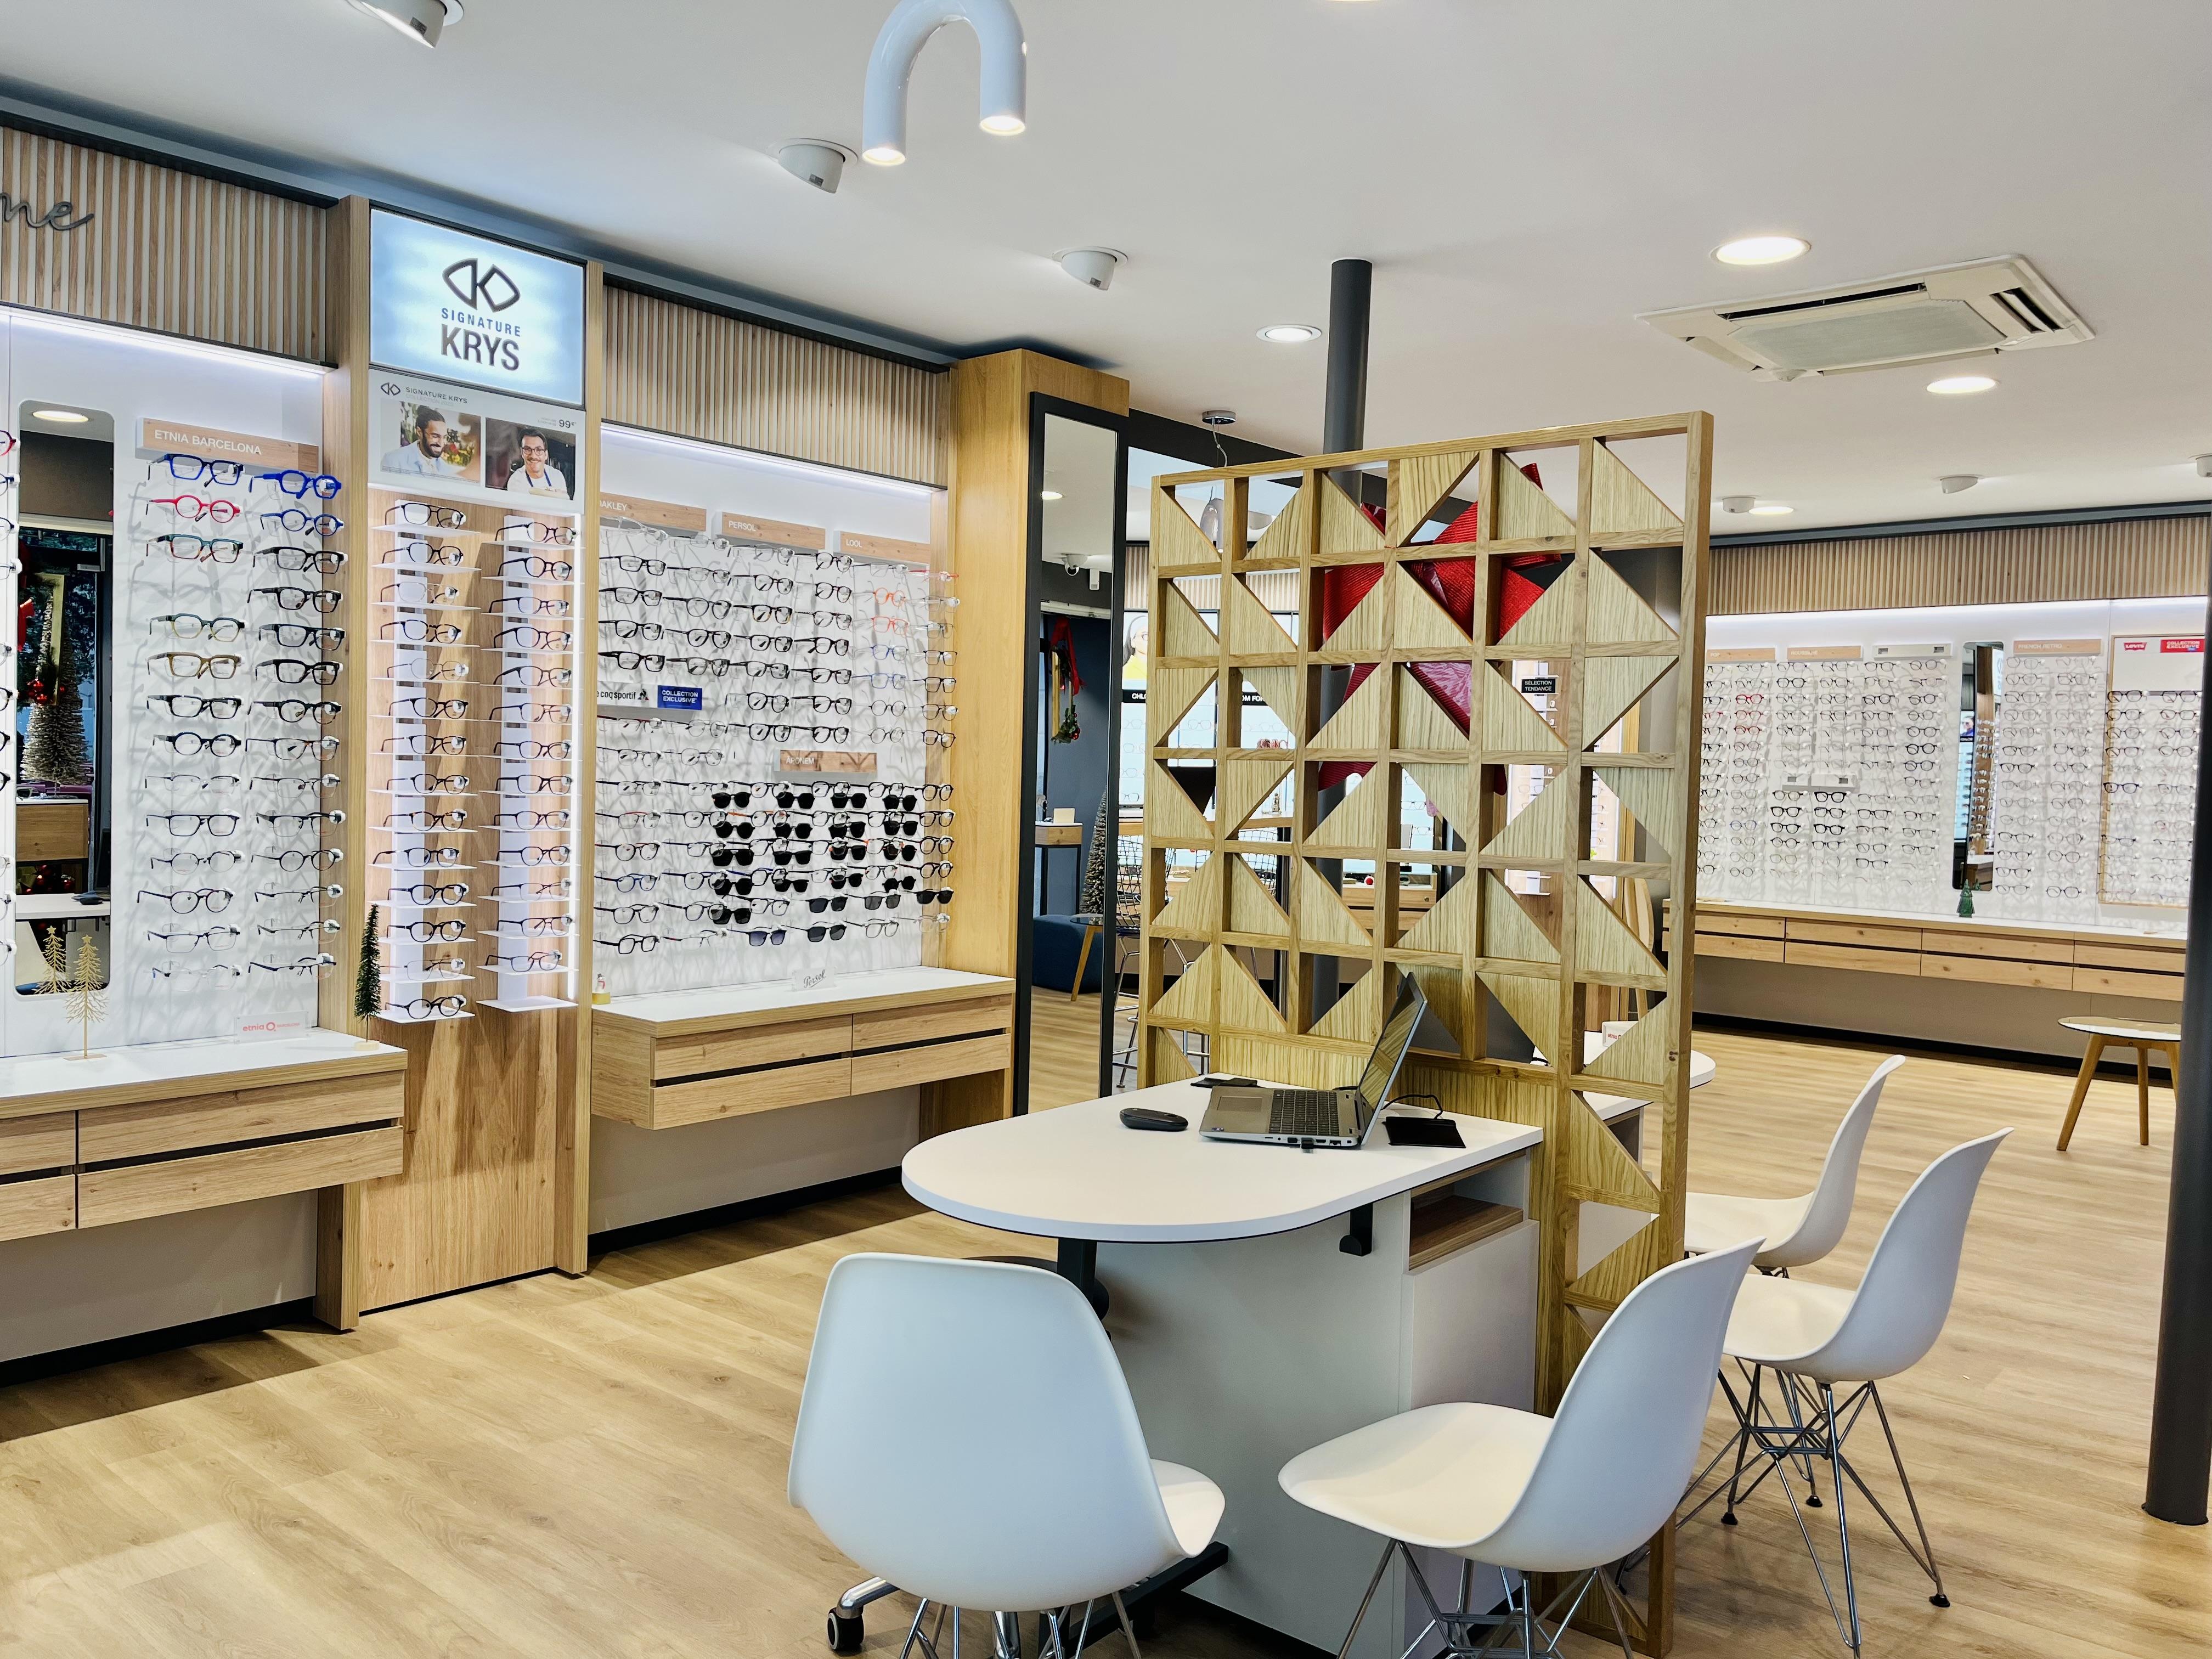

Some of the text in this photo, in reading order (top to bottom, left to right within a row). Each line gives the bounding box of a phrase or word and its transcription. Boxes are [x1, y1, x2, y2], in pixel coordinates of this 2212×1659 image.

[441, 308, 521, 337] SIGNATURE
[441, 324, 520, 371] KRYS
[406, 387, 467, 404] SIGNATURE KRYS
[155, 430, 262, 455] ETNIA BARCELONA
[729, 521, 757, 532] PERSOL
[846, 539, 862, 548] LOOL
[600, 691, 613, 699] coq
[614, 691, 636, 700] sportif
[662, 690, 698, 698] COLLECTION
[803, 969, 826, 988] Persol
